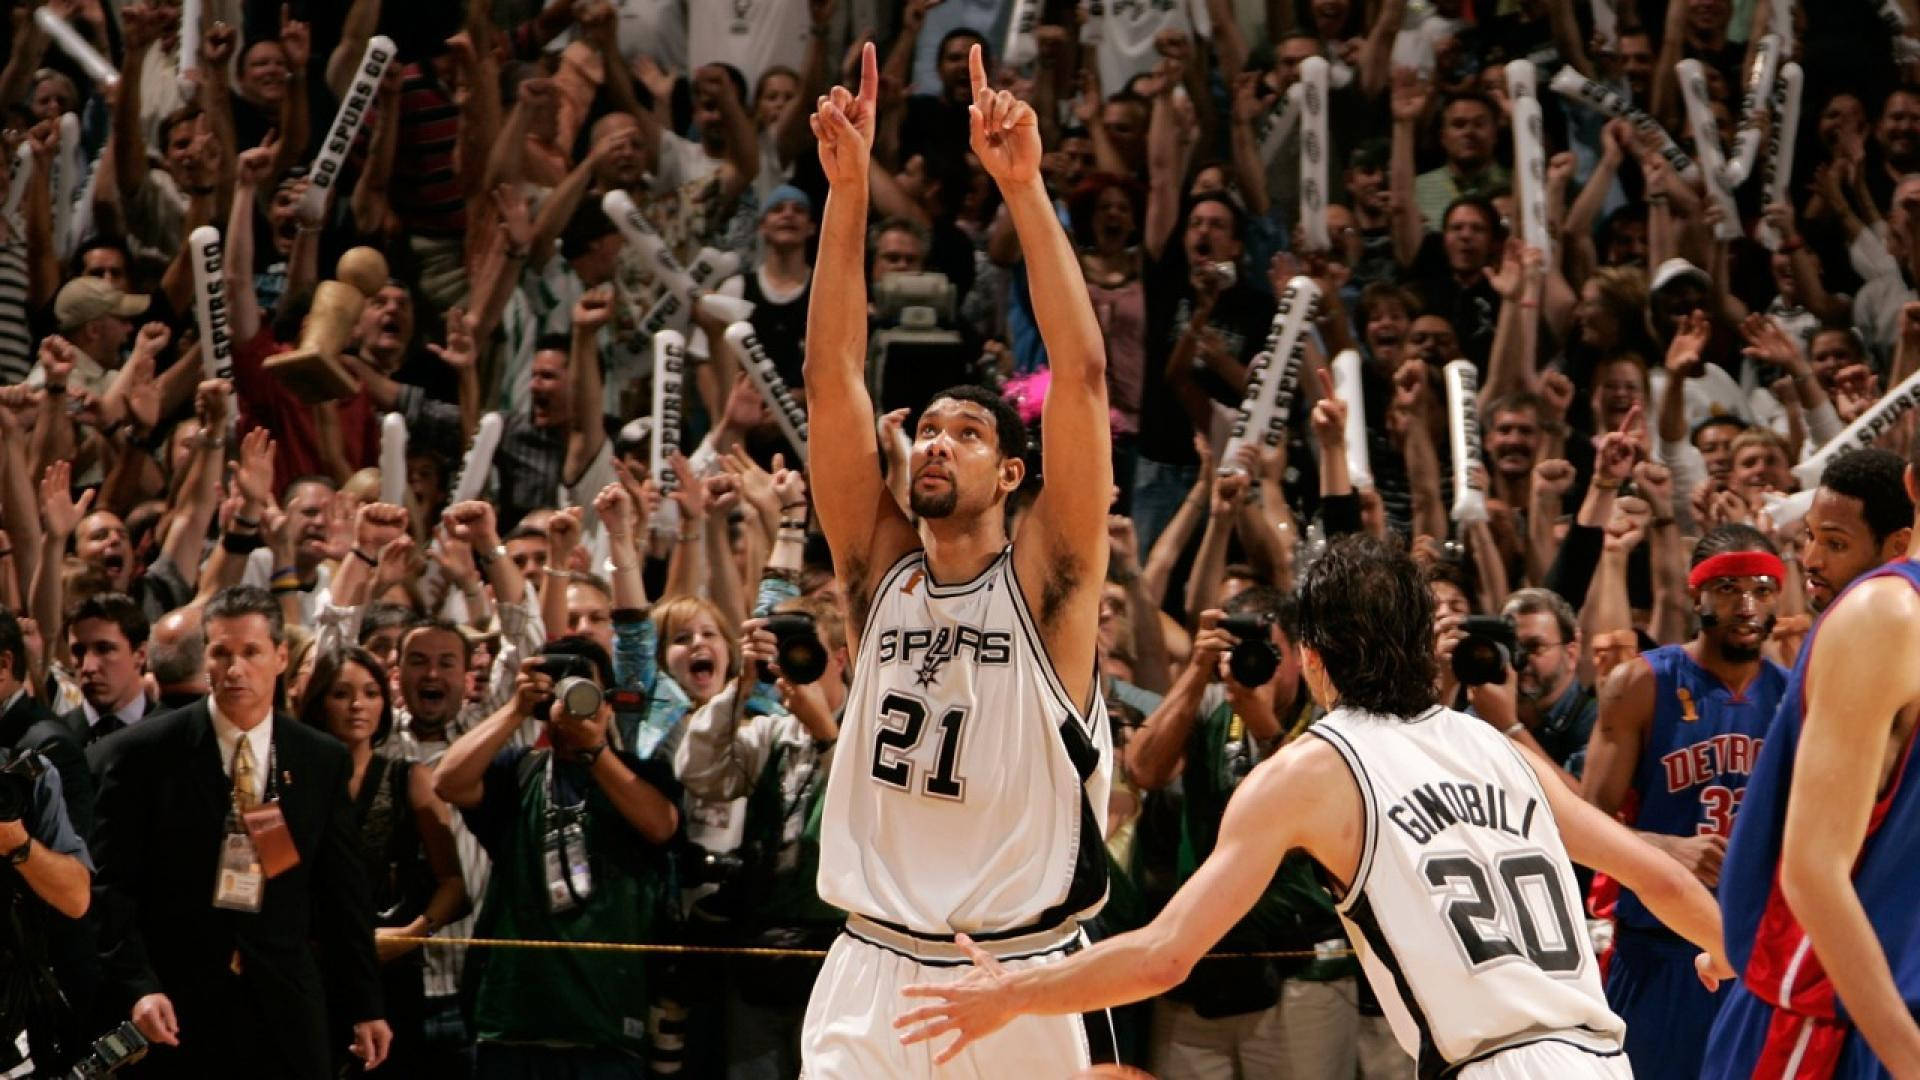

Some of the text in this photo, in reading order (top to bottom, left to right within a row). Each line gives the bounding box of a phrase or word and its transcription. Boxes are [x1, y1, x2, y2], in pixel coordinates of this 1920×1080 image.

[314, 49, 388, 188] GO SPURS GO
[204, 242, 223, 274] GO
[207, 281, 231, 359] SPURS
[662, 382, 682, 459] SPURS
[878, 624, 1012, 667] SPURS
[870, 687, 971, 804] 21
[1387, 782, 1537, 845] GINOBILI
[1415, 847, 1586, 981] 20
